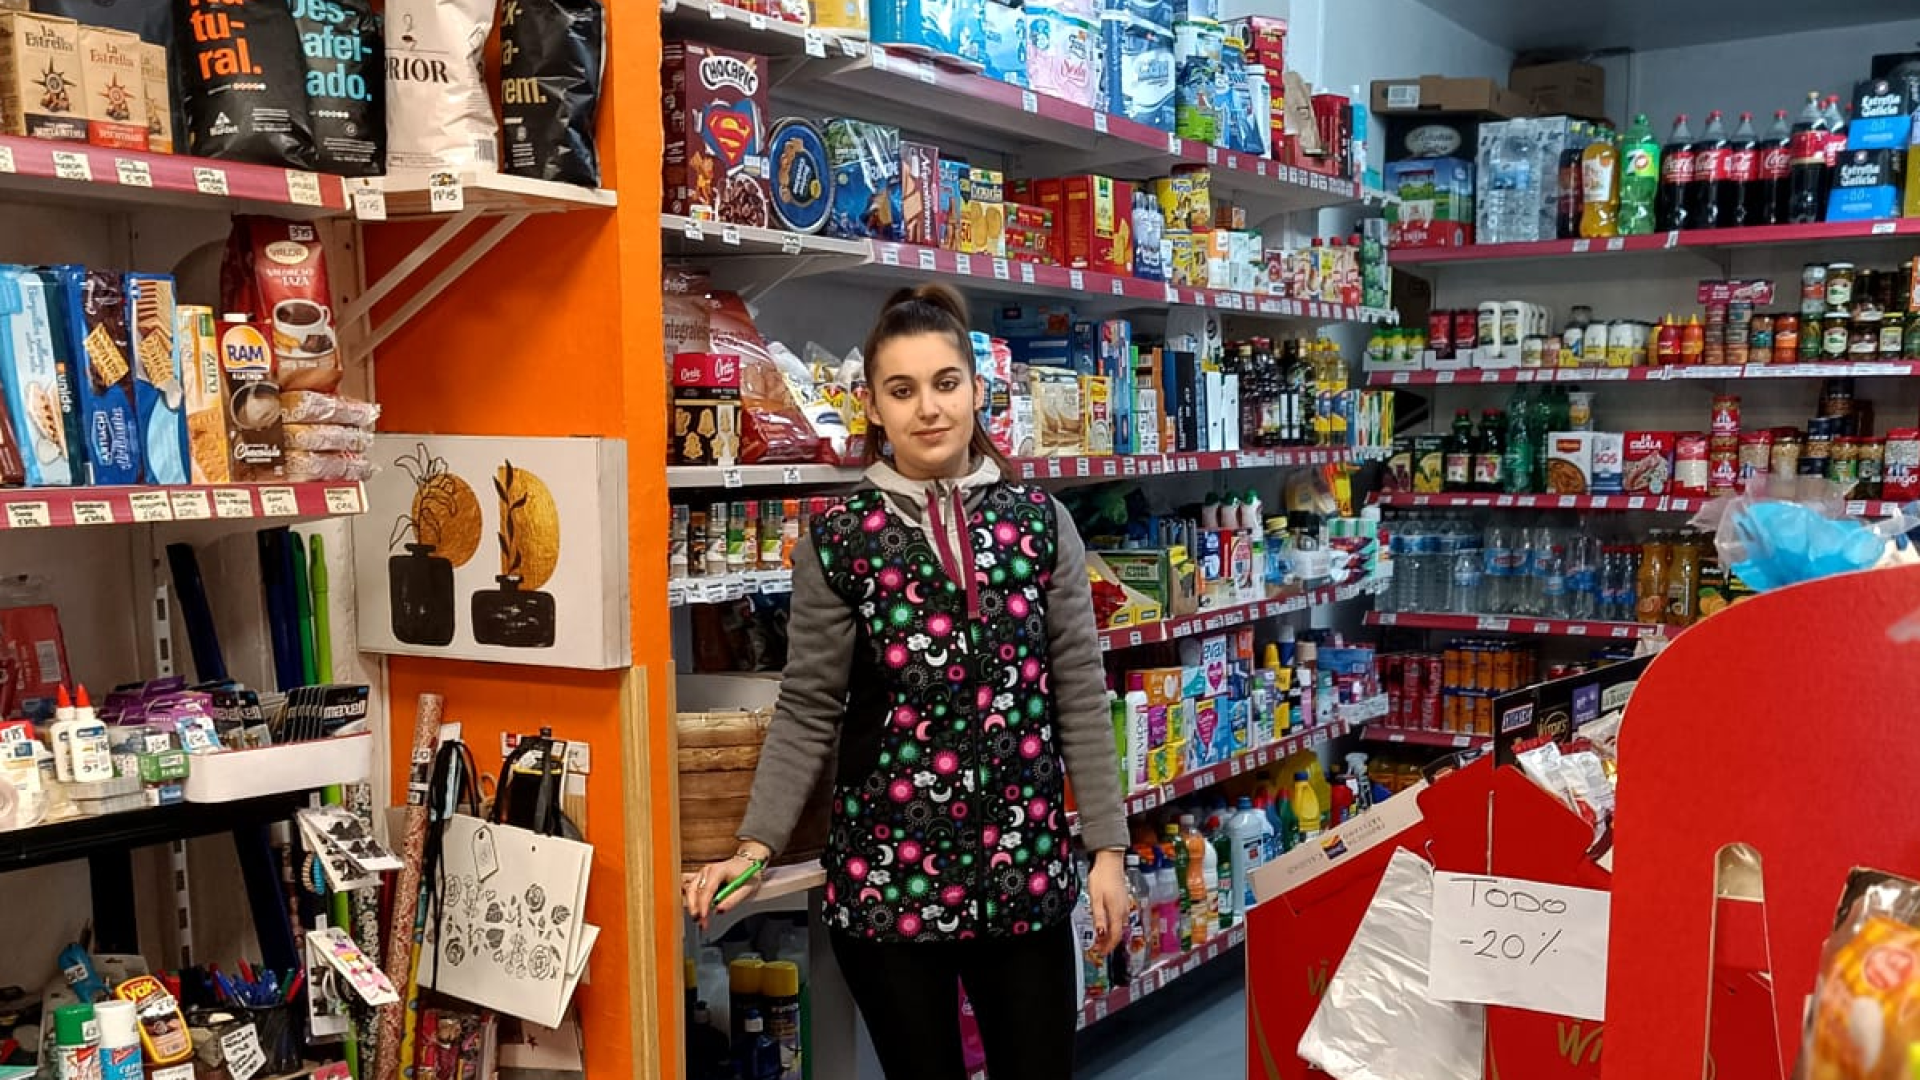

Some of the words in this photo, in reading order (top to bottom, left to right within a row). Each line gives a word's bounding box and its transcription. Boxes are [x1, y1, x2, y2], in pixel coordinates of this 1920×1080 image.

[190, 10, 245, 41] tu-
[25, 31, 74, 53] Estrella
[301, 26, 373, 61] afei-
[90, 50, 134, 70] Estrella
[199, 37, 263, 80] ral.
[385, 57, 449, 83] RIOR
[702, 57, 758, 92] CHOCAPIC
[1861, 96, 1900, 108] Estrella
[1861, 105, 1899, 118] Galicia
[1840, 175, 1878, 187] Galicia
[1841, 164, 1880, 176] Estrella
[664, 318, 710, 343] ntegrales
[226, 344, 264, 362] RAM
[1595, 453, 1618, 464] SOS
[324, 700, 367, 718] maxell
[1450, 878, 1566, 914] TODO
[1459, 929, 1563, 966] -20%
